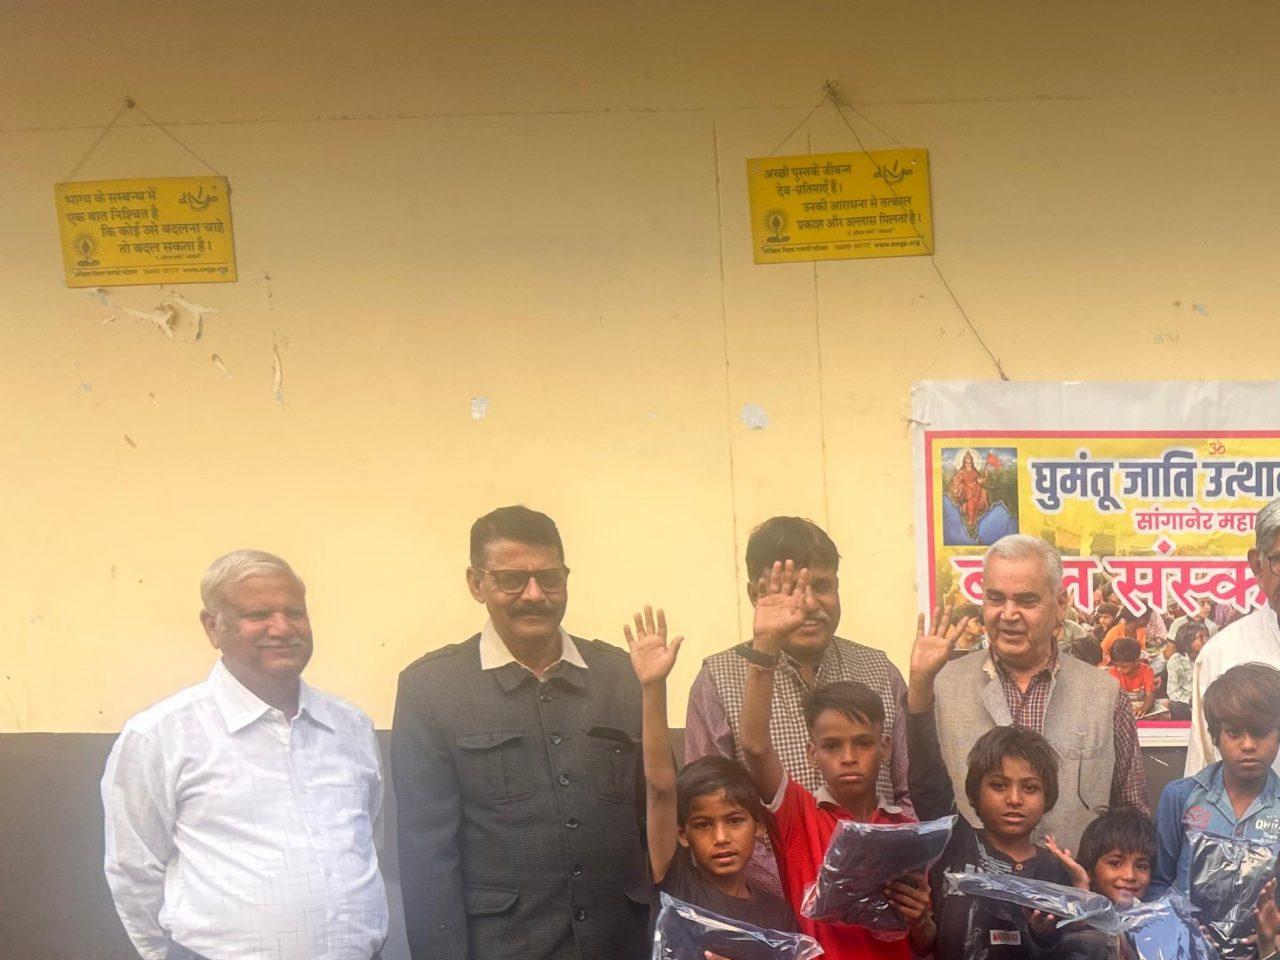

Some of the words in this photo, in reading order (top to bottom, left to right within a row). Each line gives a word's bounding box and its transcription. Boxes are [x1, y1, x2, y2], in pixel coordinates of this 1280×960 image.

[1031, 451, 1123, 511] घुमंतू
[1118, 450, 1198, 498] जाति
[1135, 507, 1214, 531] सांगानेर
